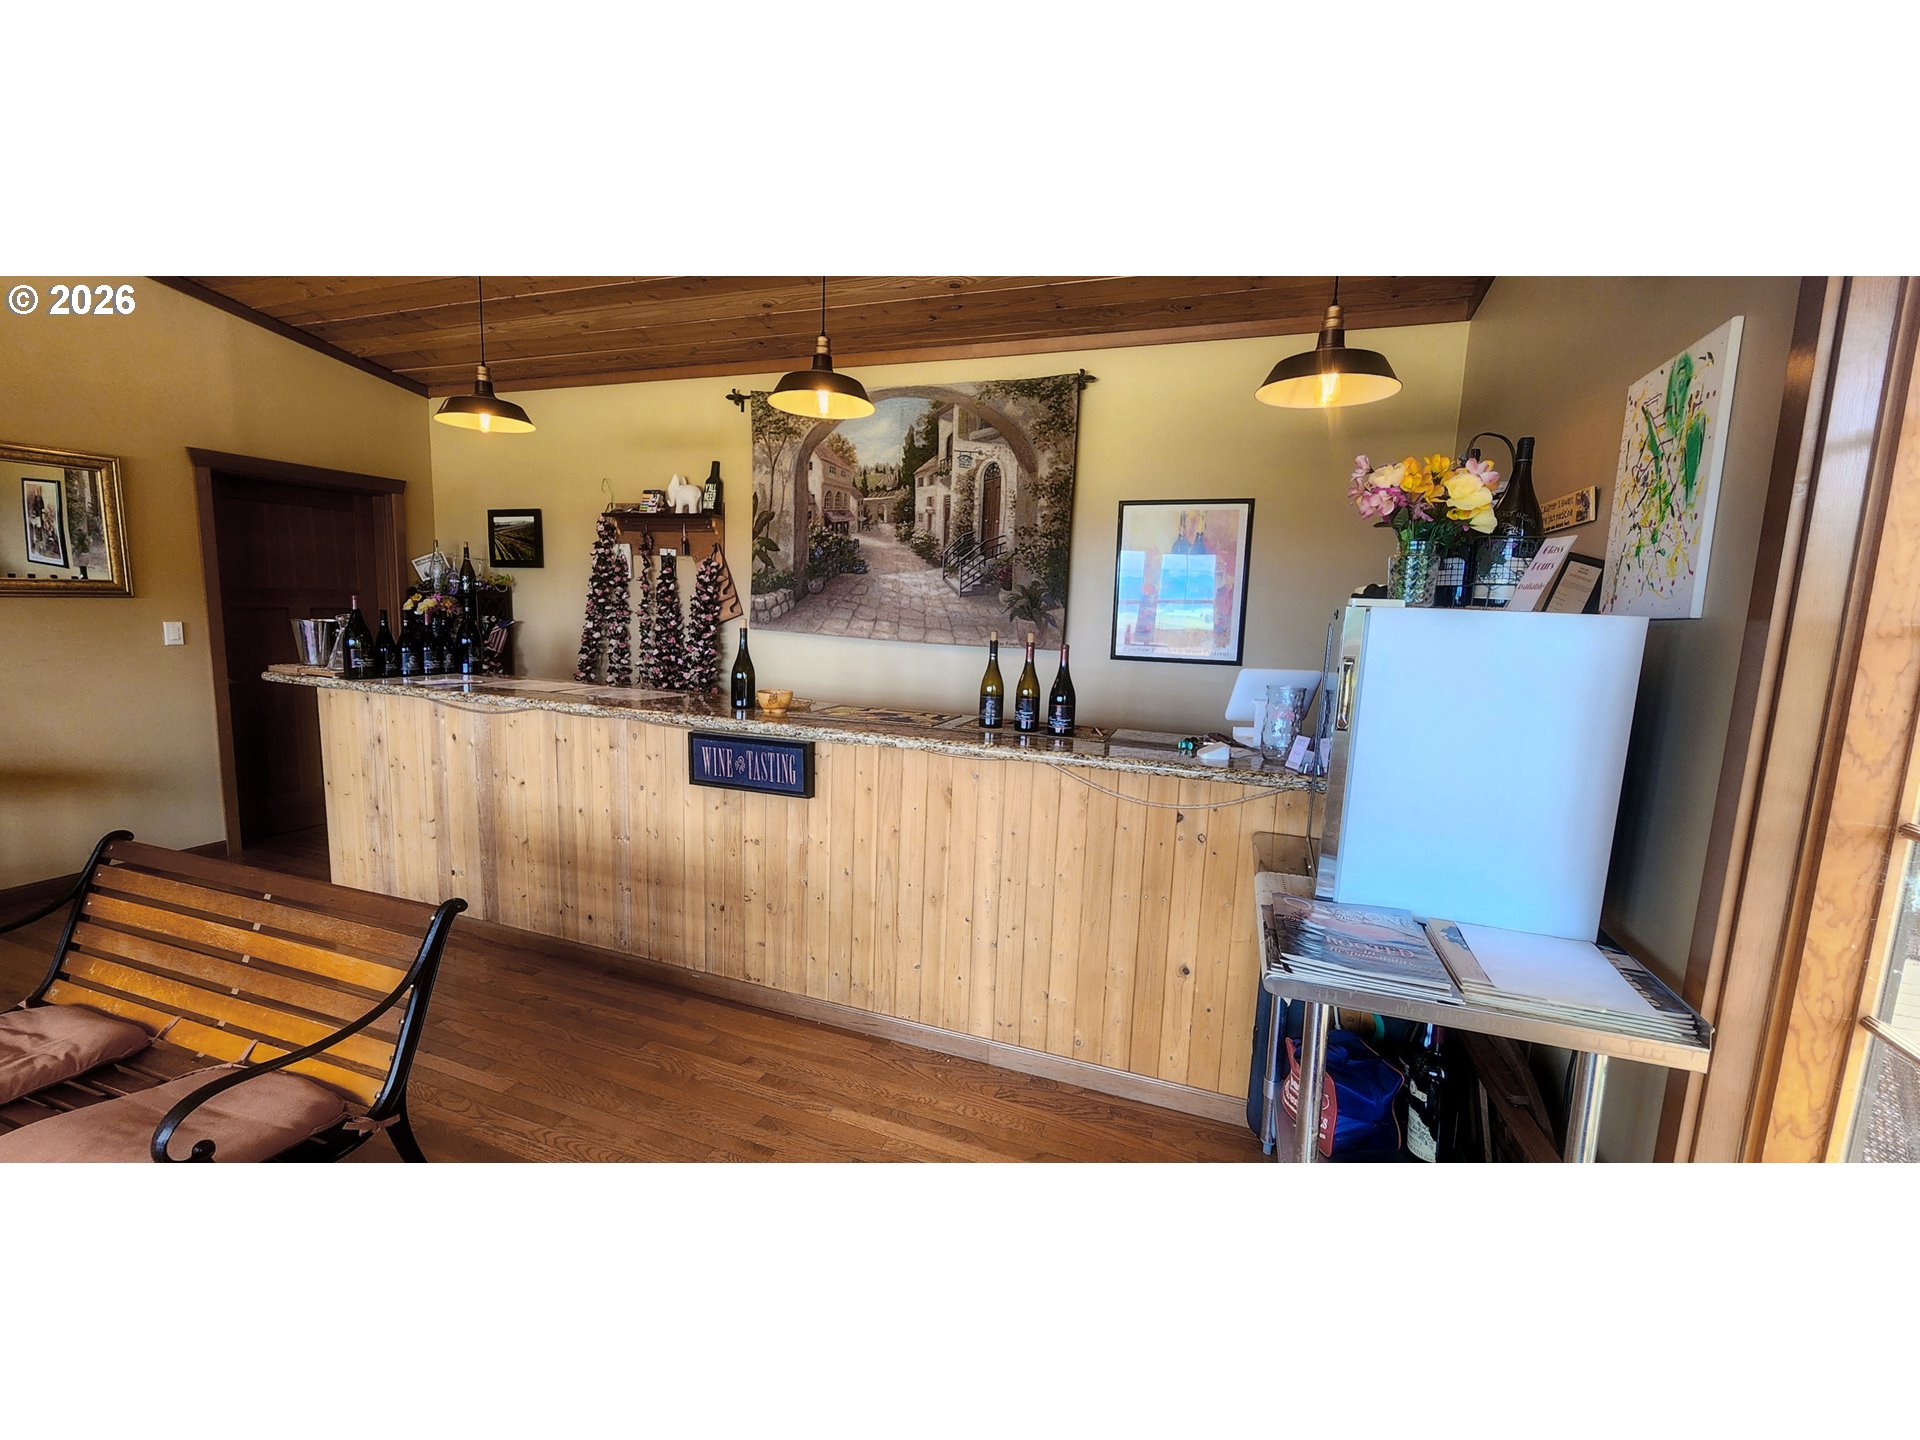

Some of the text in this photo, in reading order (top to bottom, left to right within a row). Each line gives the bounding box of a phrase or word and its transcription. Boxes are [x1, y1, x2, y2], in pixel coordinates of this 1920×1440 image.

[705, 483, 717, 493] Y'ALL
[703, 492, 717, 502] NEED
[702, 746, 796, 785] WINE TASTING
